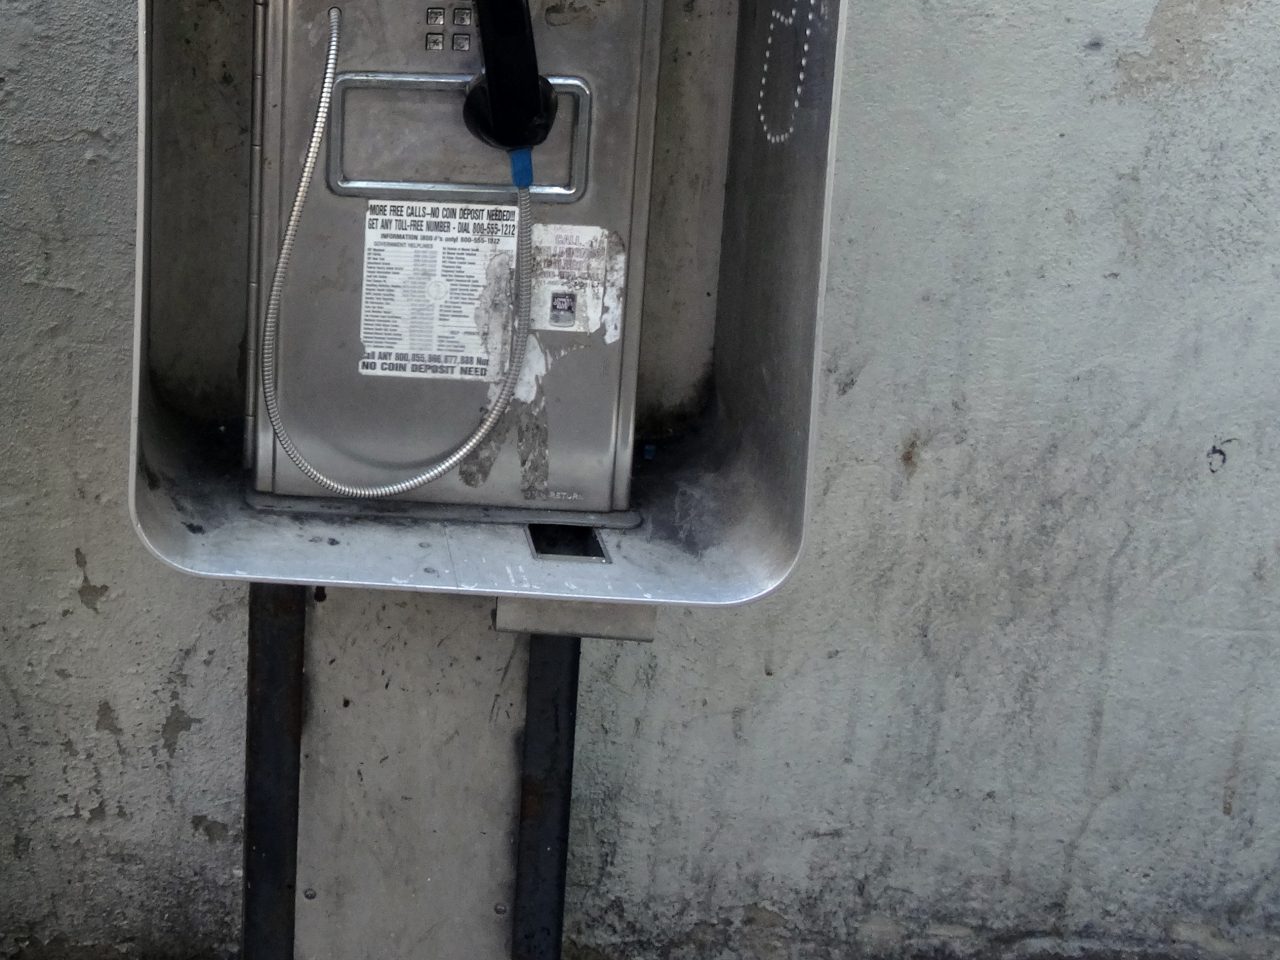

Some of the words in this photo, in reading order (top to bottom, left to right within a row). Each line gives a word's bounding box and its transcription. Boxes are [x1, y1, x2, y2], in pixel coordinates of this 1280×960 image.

[370, 204, 387, 216] MORE
[389, 205, 404, 217] FREE
[442, 207, 456, 219] COIN
[458, 208, 485, 220] DEPOSIT
[368, 218, 379, 229] GET
[380, 219, 393, 230] ANY
[395, 219, 424, 231] TOLL-FREE
[426, 220, 451, 232] NUMBER
[457, 223, 470, 234] DIAL
[378, 352, 393, 361] ANY
[361, 361, 377, 371] NO
[380, 361, 407, 372] COIN
[410, 363, 456, 375] DEPOSIT
